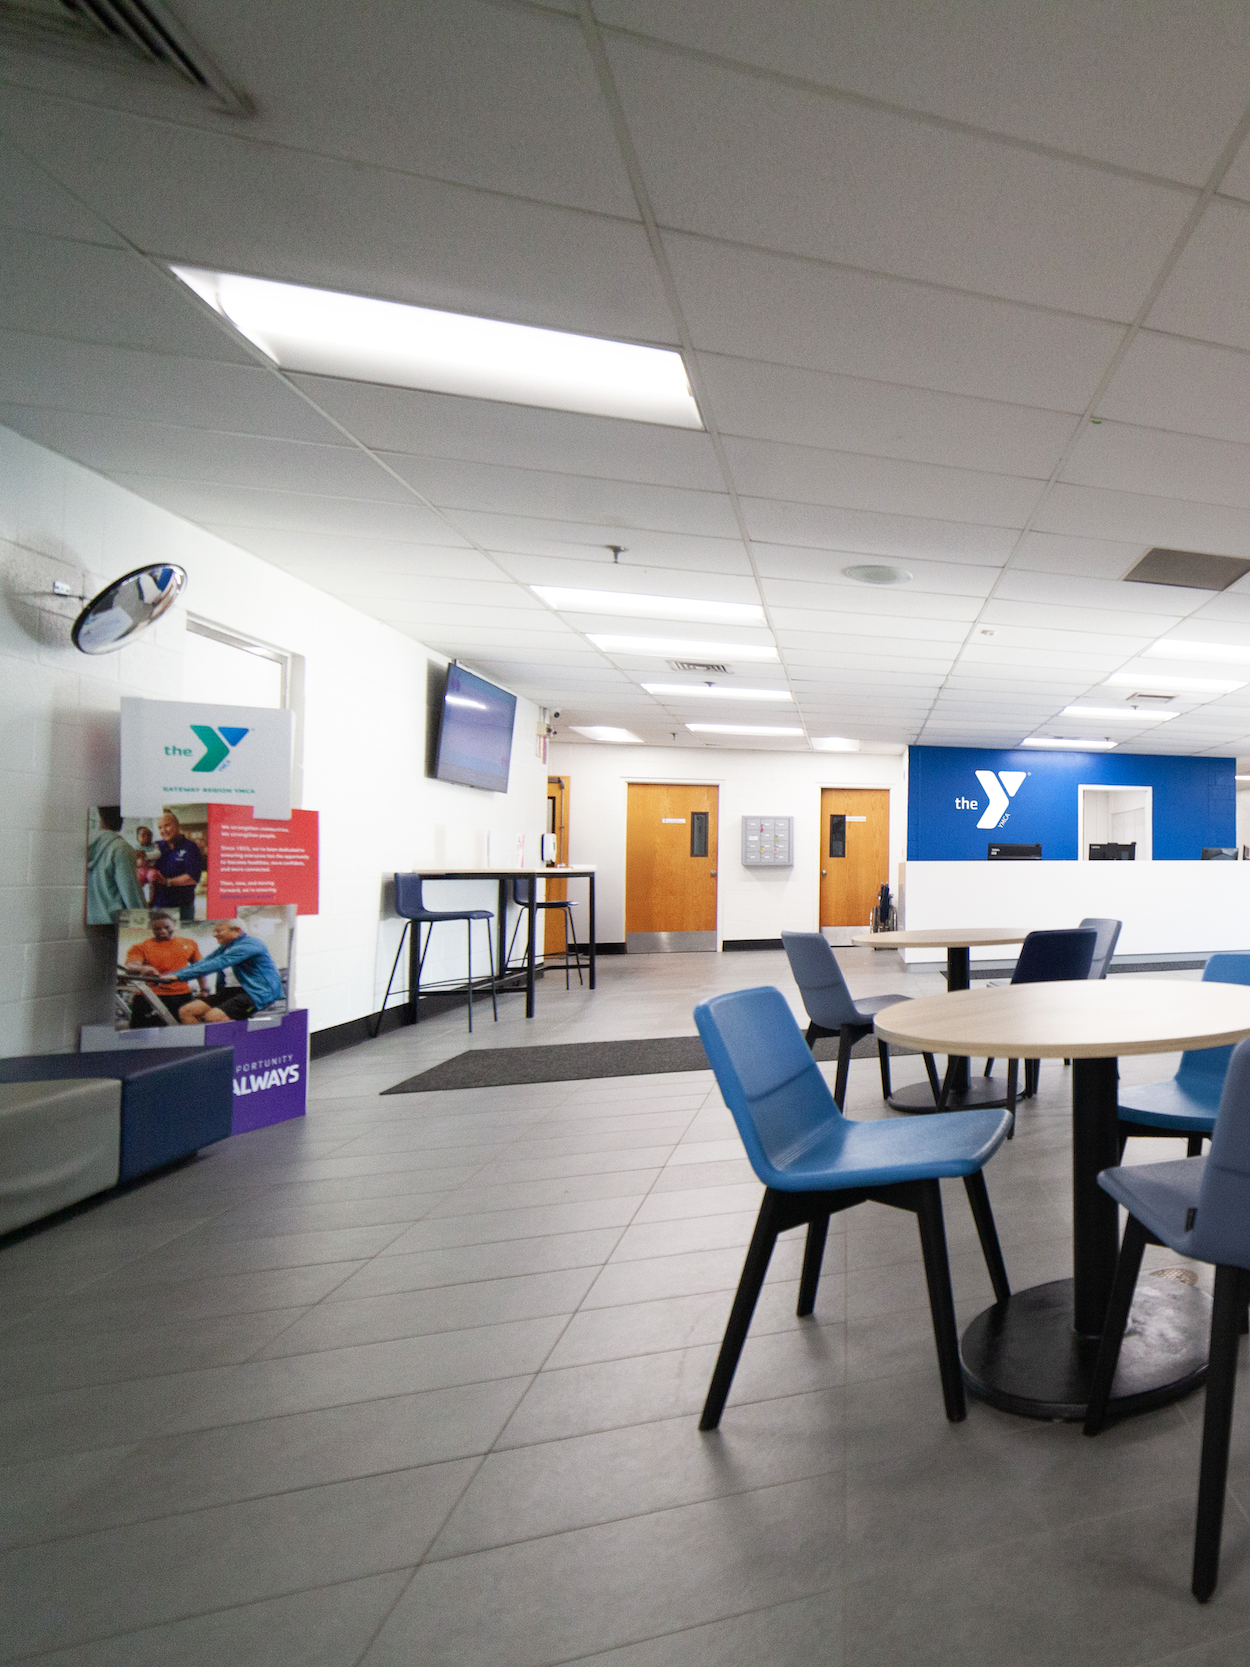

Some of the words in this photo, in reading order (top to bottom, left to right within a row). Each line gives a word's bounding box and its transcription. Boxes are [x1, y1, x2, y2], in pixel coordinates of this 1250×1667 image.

[164, 745, 192, 757] the
[955, 796, 978, 810] the
[997, 812, 1011, 828] YMCA
[236, 1054, 293, 1073] PORTUNITY
[233, 1064, 299, 1096] ALWAYS
